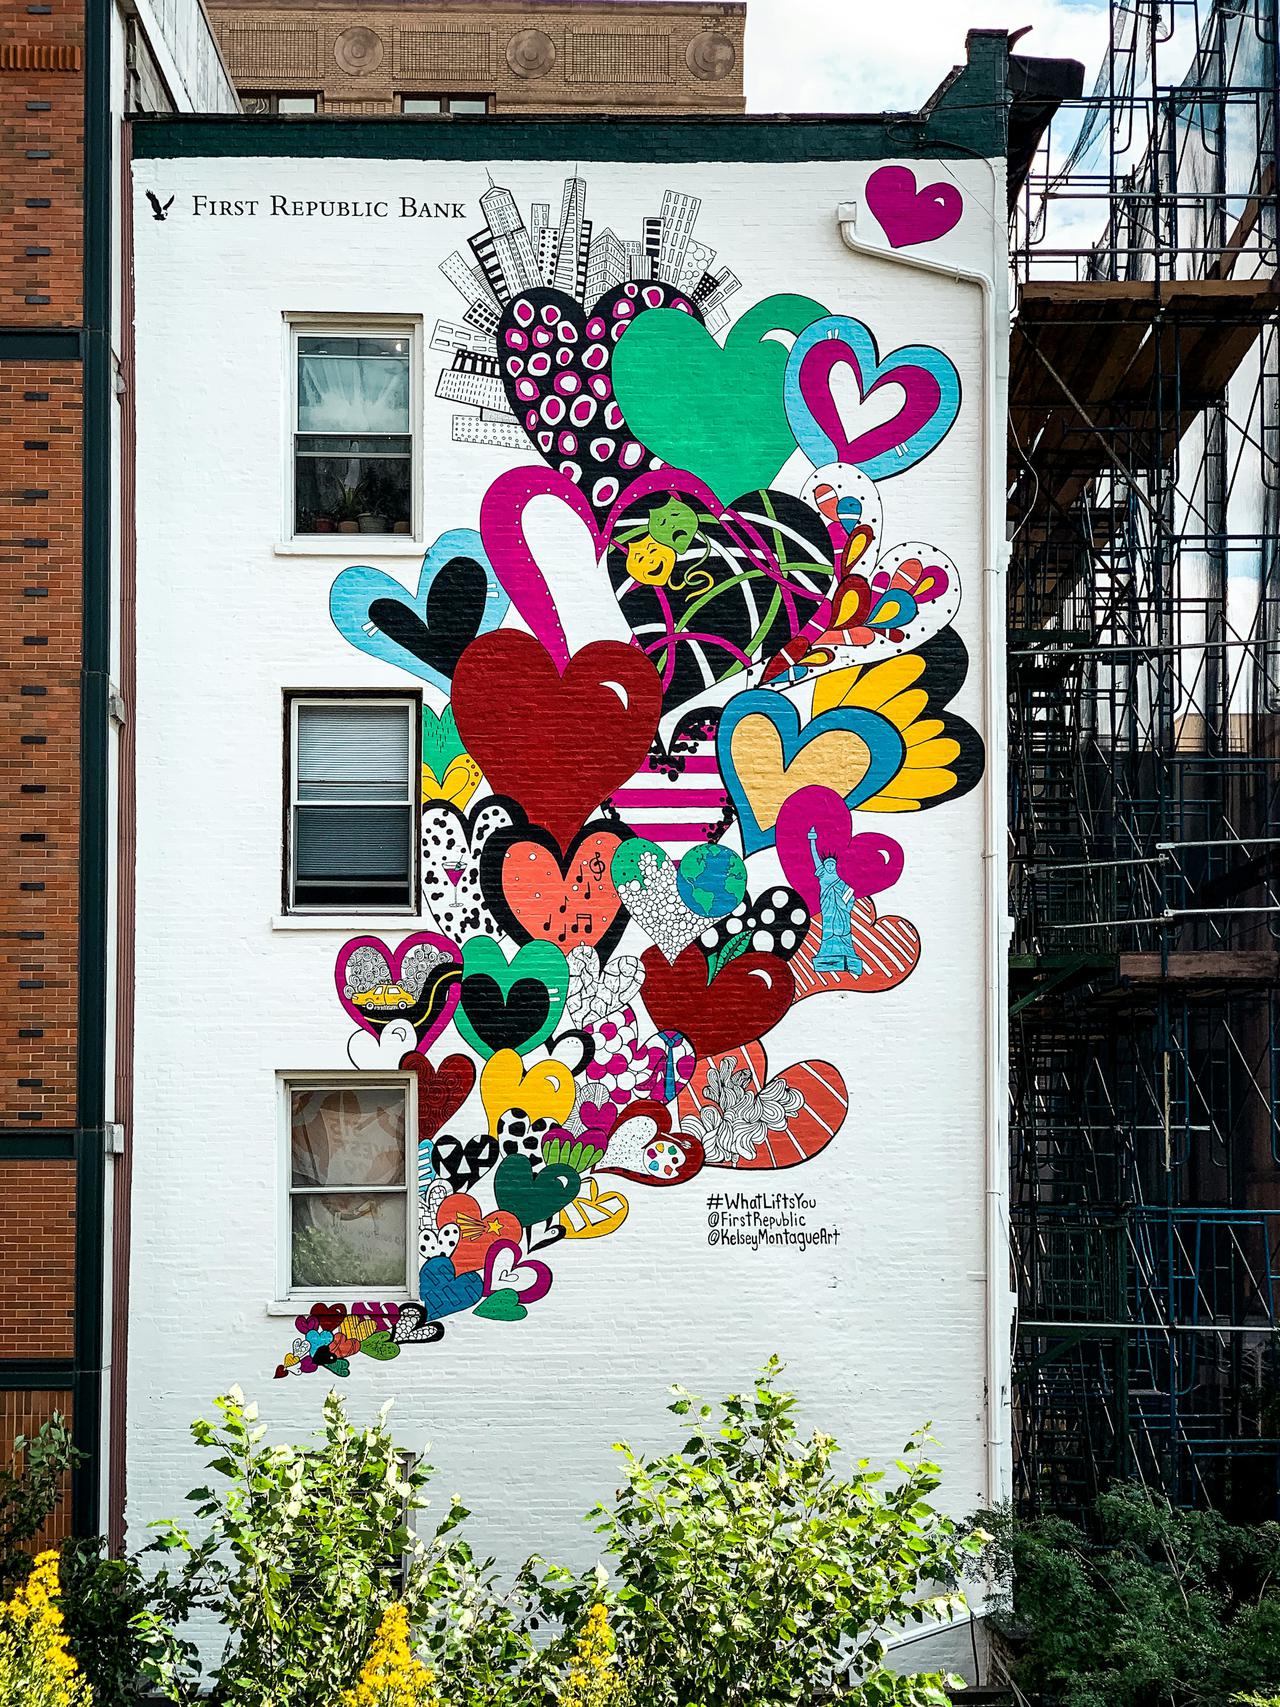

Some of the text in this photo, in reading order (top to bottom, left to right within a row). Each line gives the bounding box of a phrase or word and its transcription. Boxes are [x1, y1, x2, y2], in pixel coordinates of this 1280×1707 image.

[192, 195, 467, 218] FIRST REPUBLIC BANK
[706, 1193, 817, 1210] #WhatLiftsYou
[707, 1211, 807, 1229] @FirstRepublic
[707, 1228, 841, 1252] @KelseyMontagueArt
